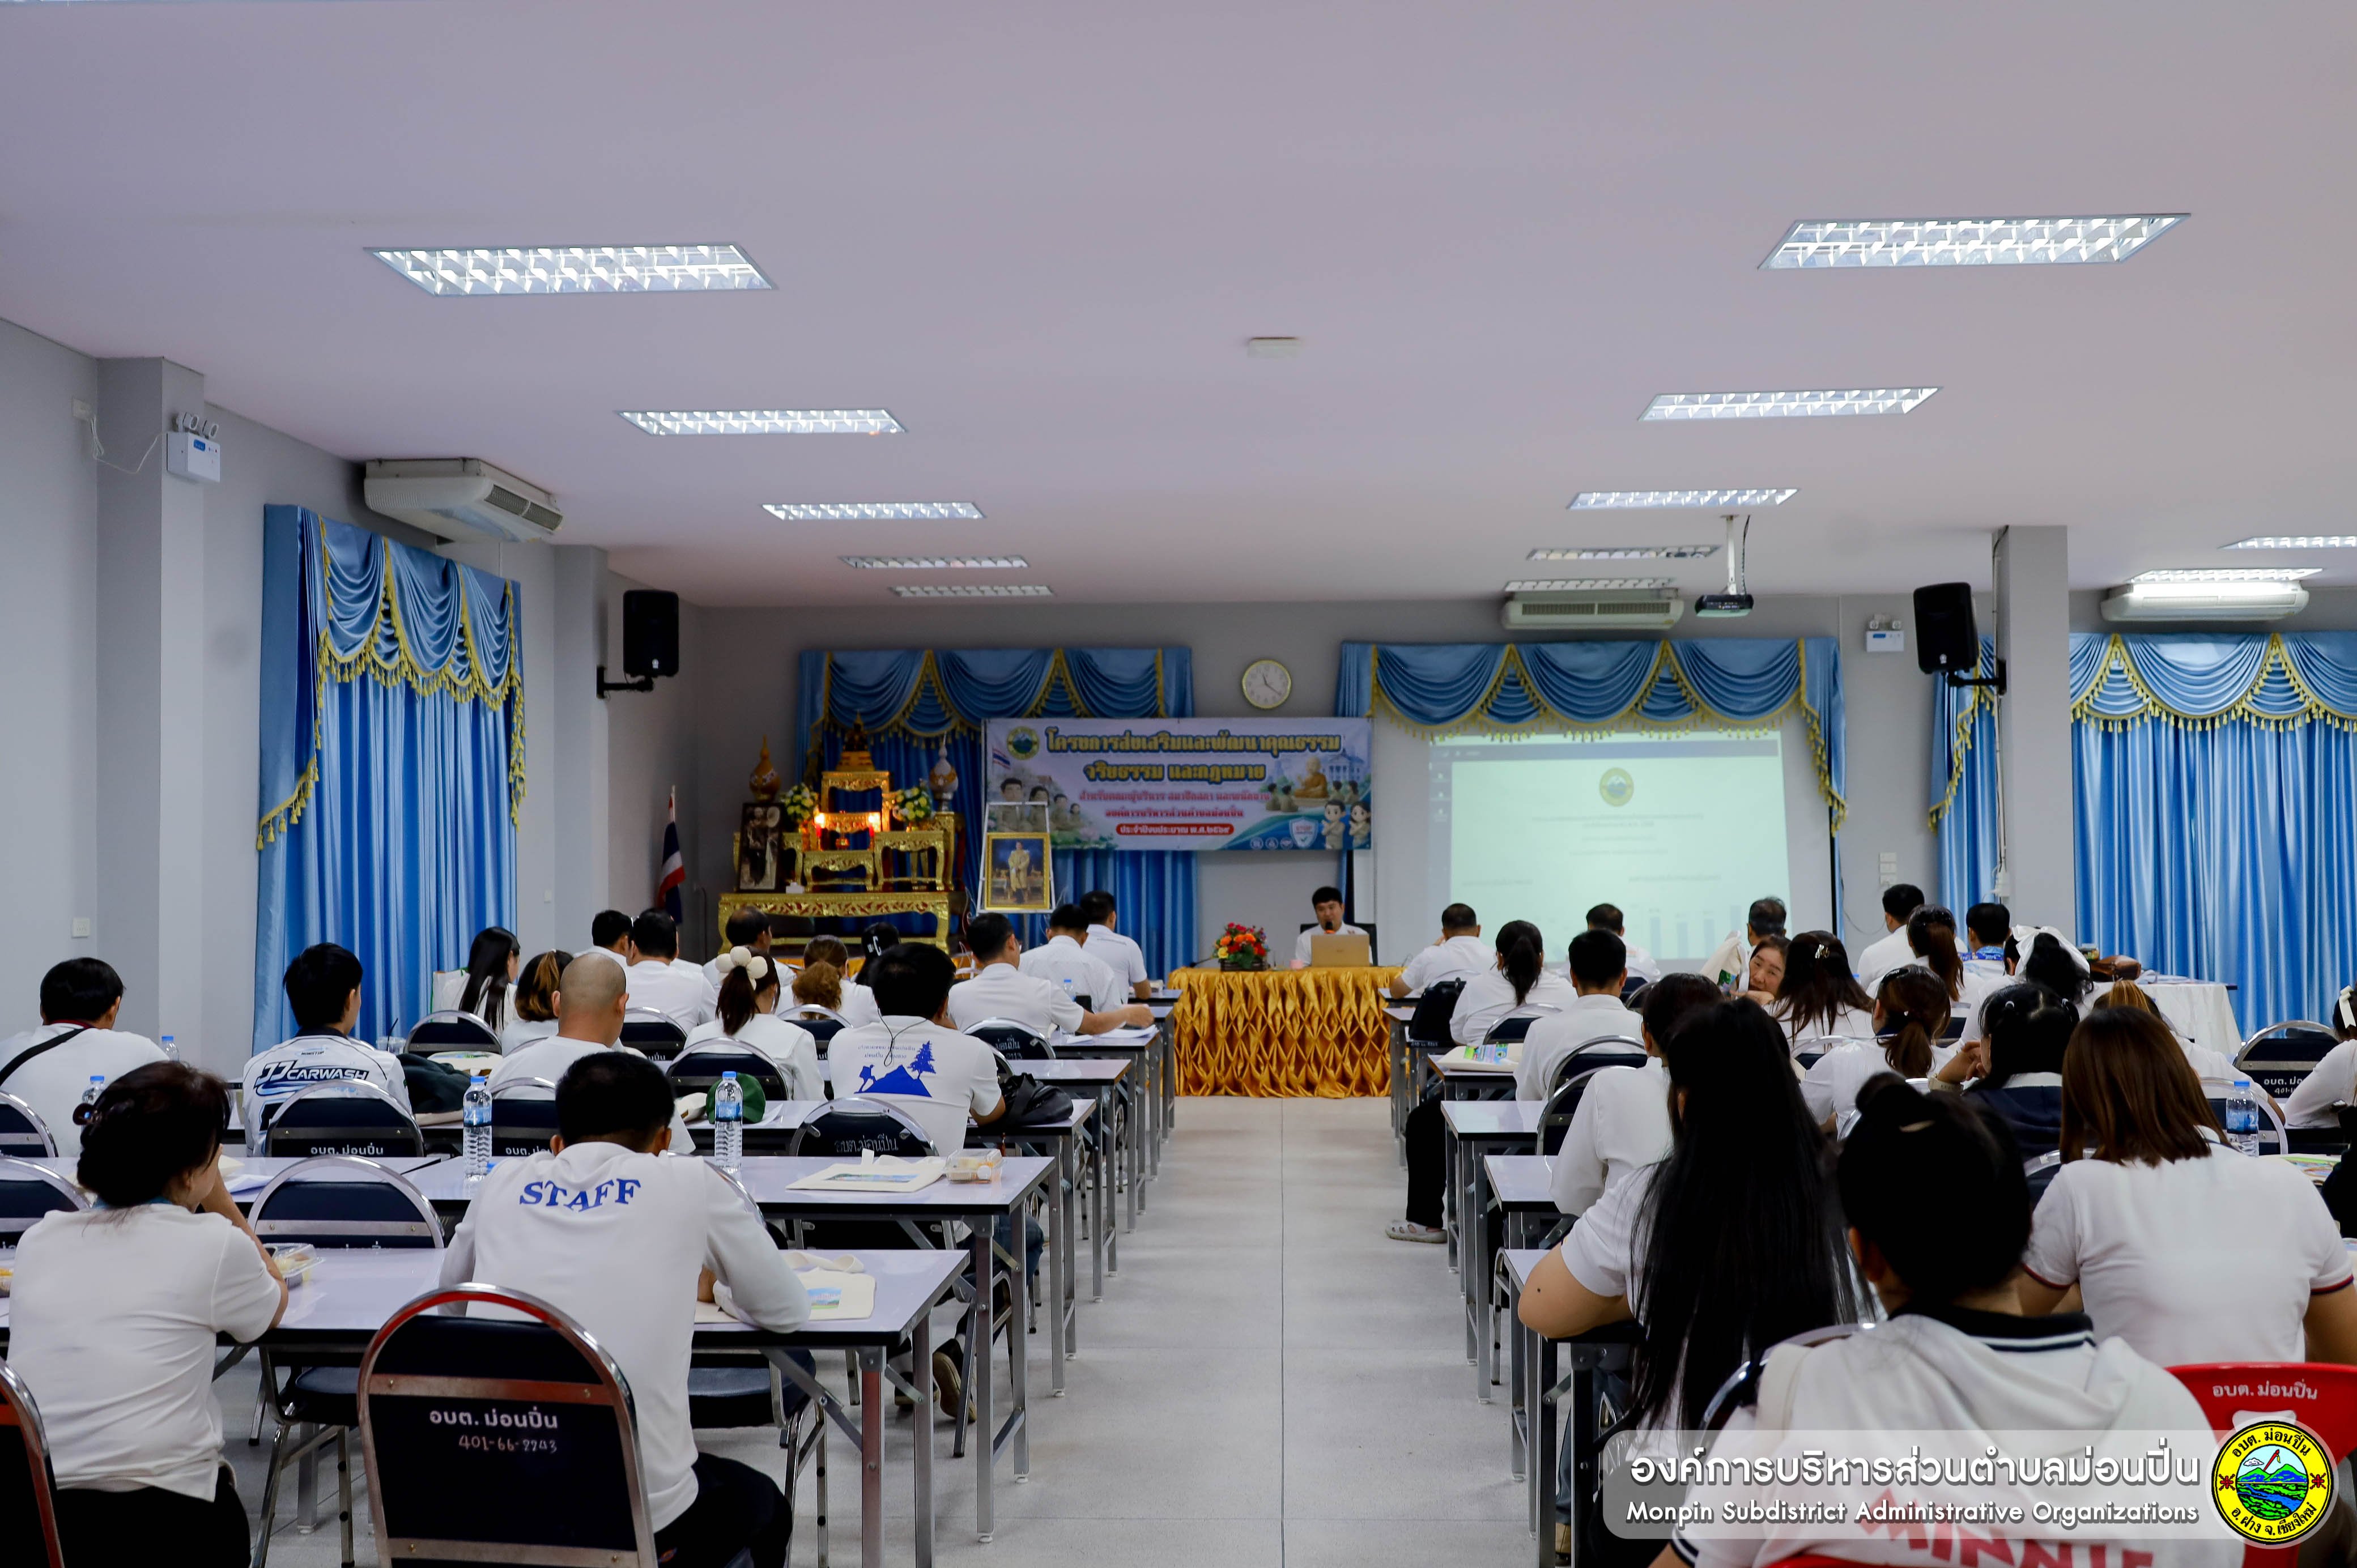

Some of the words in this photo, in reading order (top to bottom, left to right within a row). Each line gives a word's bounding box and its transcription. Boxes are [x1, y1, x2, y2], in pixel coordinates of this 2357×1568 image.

[1084, 761, 1164, 781] จริยธรรม
[520, 1178, 641, 1212] STAFF
[2212, 1384, 2254, 1397] อบต.
[2257, 1379, 2318, 1400] ม่อนปิ่น
[429, 1411, 479, 1426] อบต.
[484, 1406, 558, 1429] ม่อนปิ่น
